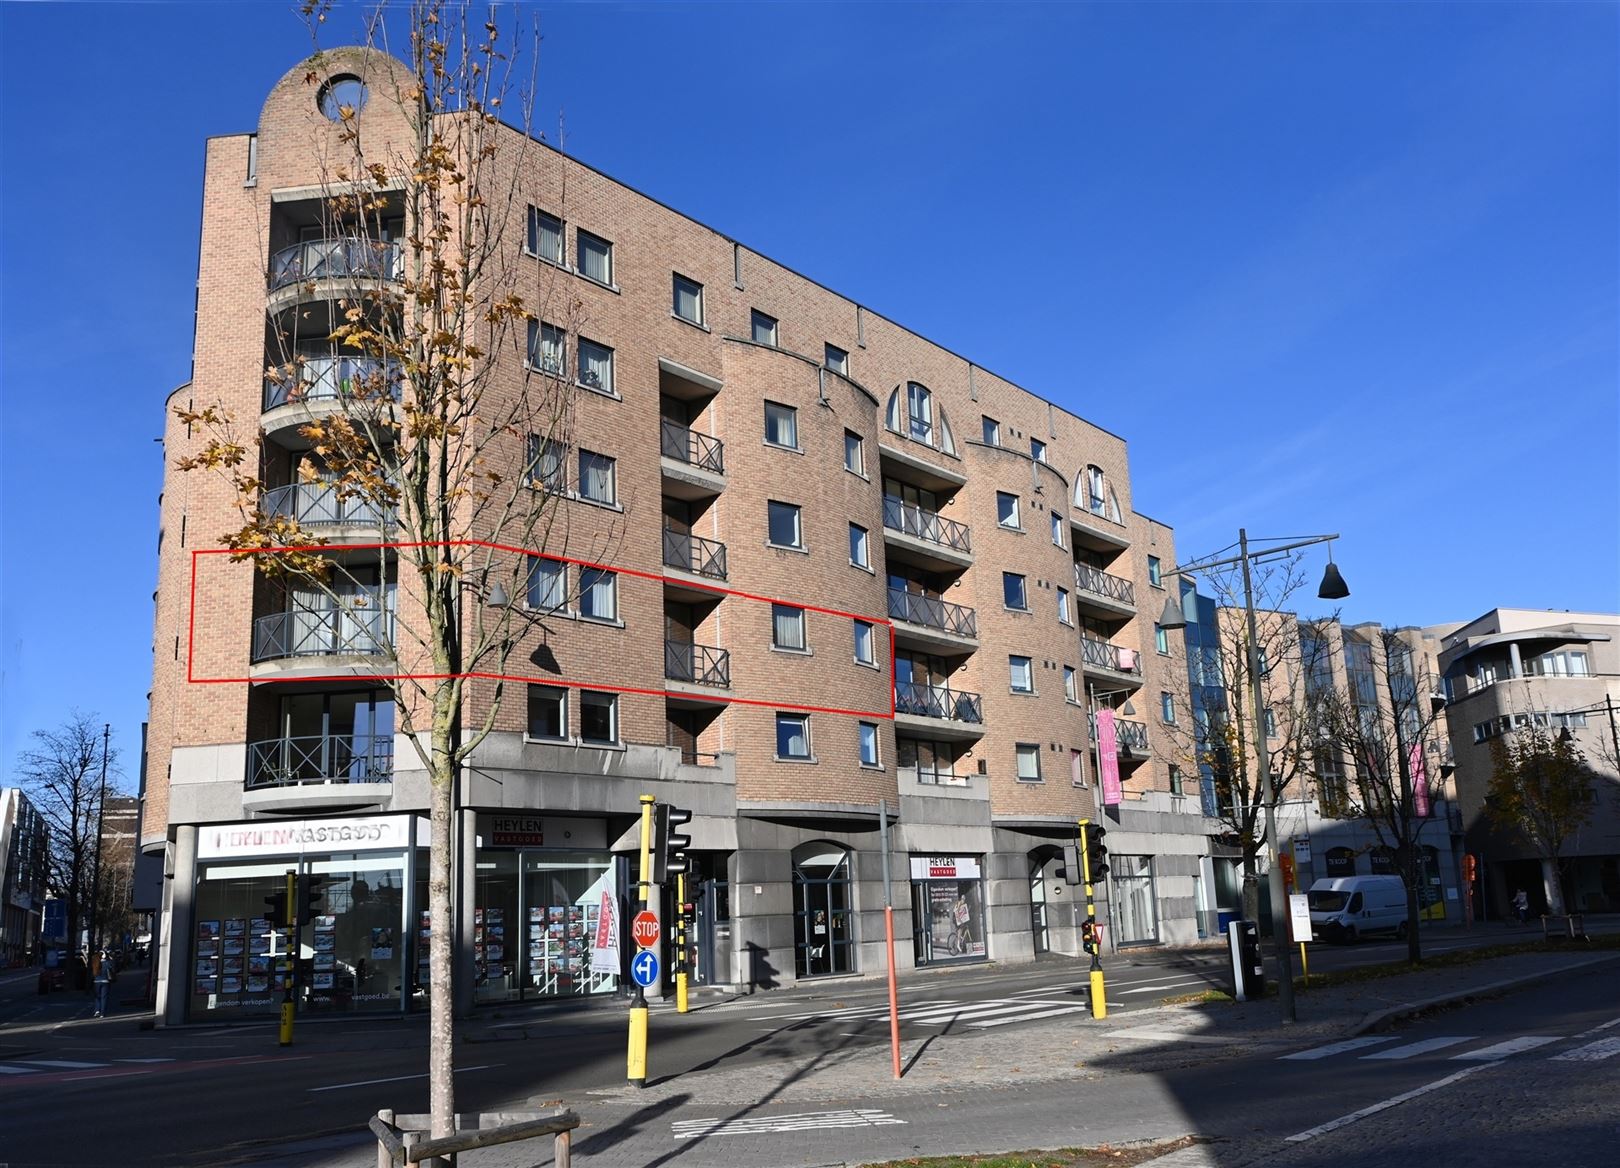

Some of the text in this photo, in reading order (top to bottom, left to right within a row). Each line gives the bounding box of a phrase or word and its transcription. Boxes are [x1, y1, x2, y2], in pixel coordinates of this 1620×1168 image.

[494, 820, 542, 831] HEYLEN
[929, 857, 955, 866] HEYLEN
[635, 921, 659, 937] STOP
